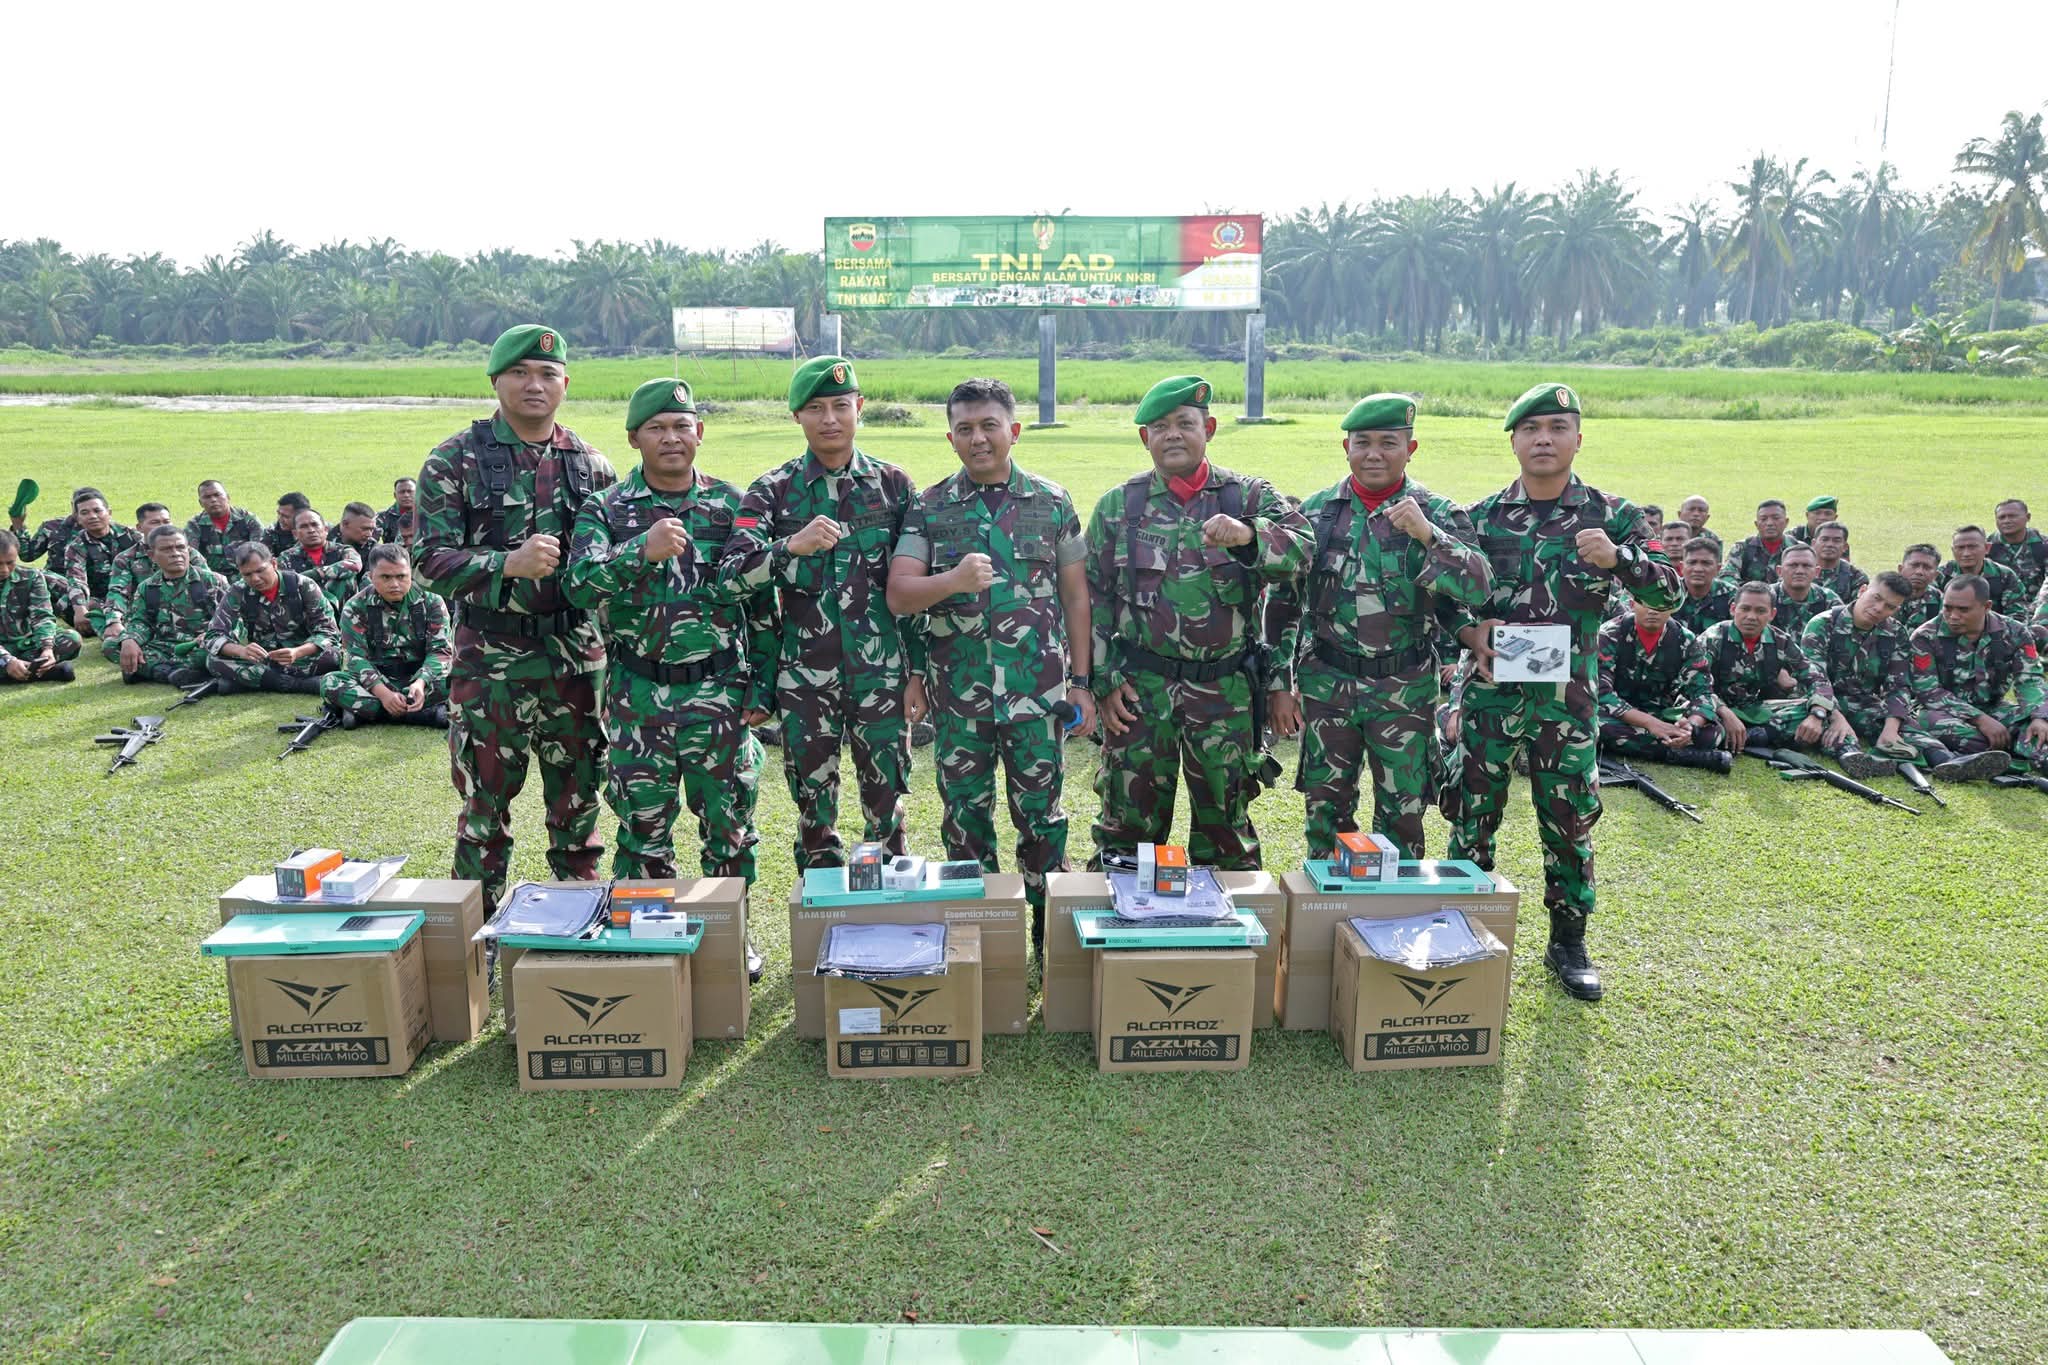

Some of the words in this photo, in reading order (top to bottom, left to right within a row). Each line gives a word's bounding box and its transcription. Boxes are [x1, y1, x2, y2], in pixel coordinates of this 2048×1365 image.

[834, 257, 892, 270] BERSAMA
[971, 253, 1042, 271] TNI
[1056, 253, 1116, 271] AD
[840, 275, 887, 288] RAKYAT
[932, 272, 987, 283] BERSATU
[991, 271, 1040, 282] DENGAN
[1043, 272, 1077, 282] ALAM
[1080, 272, 1122, 283] UNTUK
[1126, 272, 1156, 283] NKRI
[837, 293, 857, 305] TNI
[860, 292, 893, 305] KUAT
[1301, 902, 1348, 911] SAMSUNG
[798, 911, 847, 920] SAMSUNG
[1127, 1020, 1219, 1032] ALCATROZ
[1380, 1014, 1471, 1029] ALCATROZ
[267, 1022, 364, 1035] ALCATROZ
[544, 1033, 642, 1045] ALCATROZ
[1131, 1039, 1219, 1049] AZZURA
[1384, 1033, 1470, 1046] AZZURA
[276, 1042, 368, 1053] AZZURA
[1130, 1049, 1184, 1058] MILLENIA
[1383, 1045, 1436, 1056] MILLENIA
[276, 1052, 334, 1063] MILLENIA
